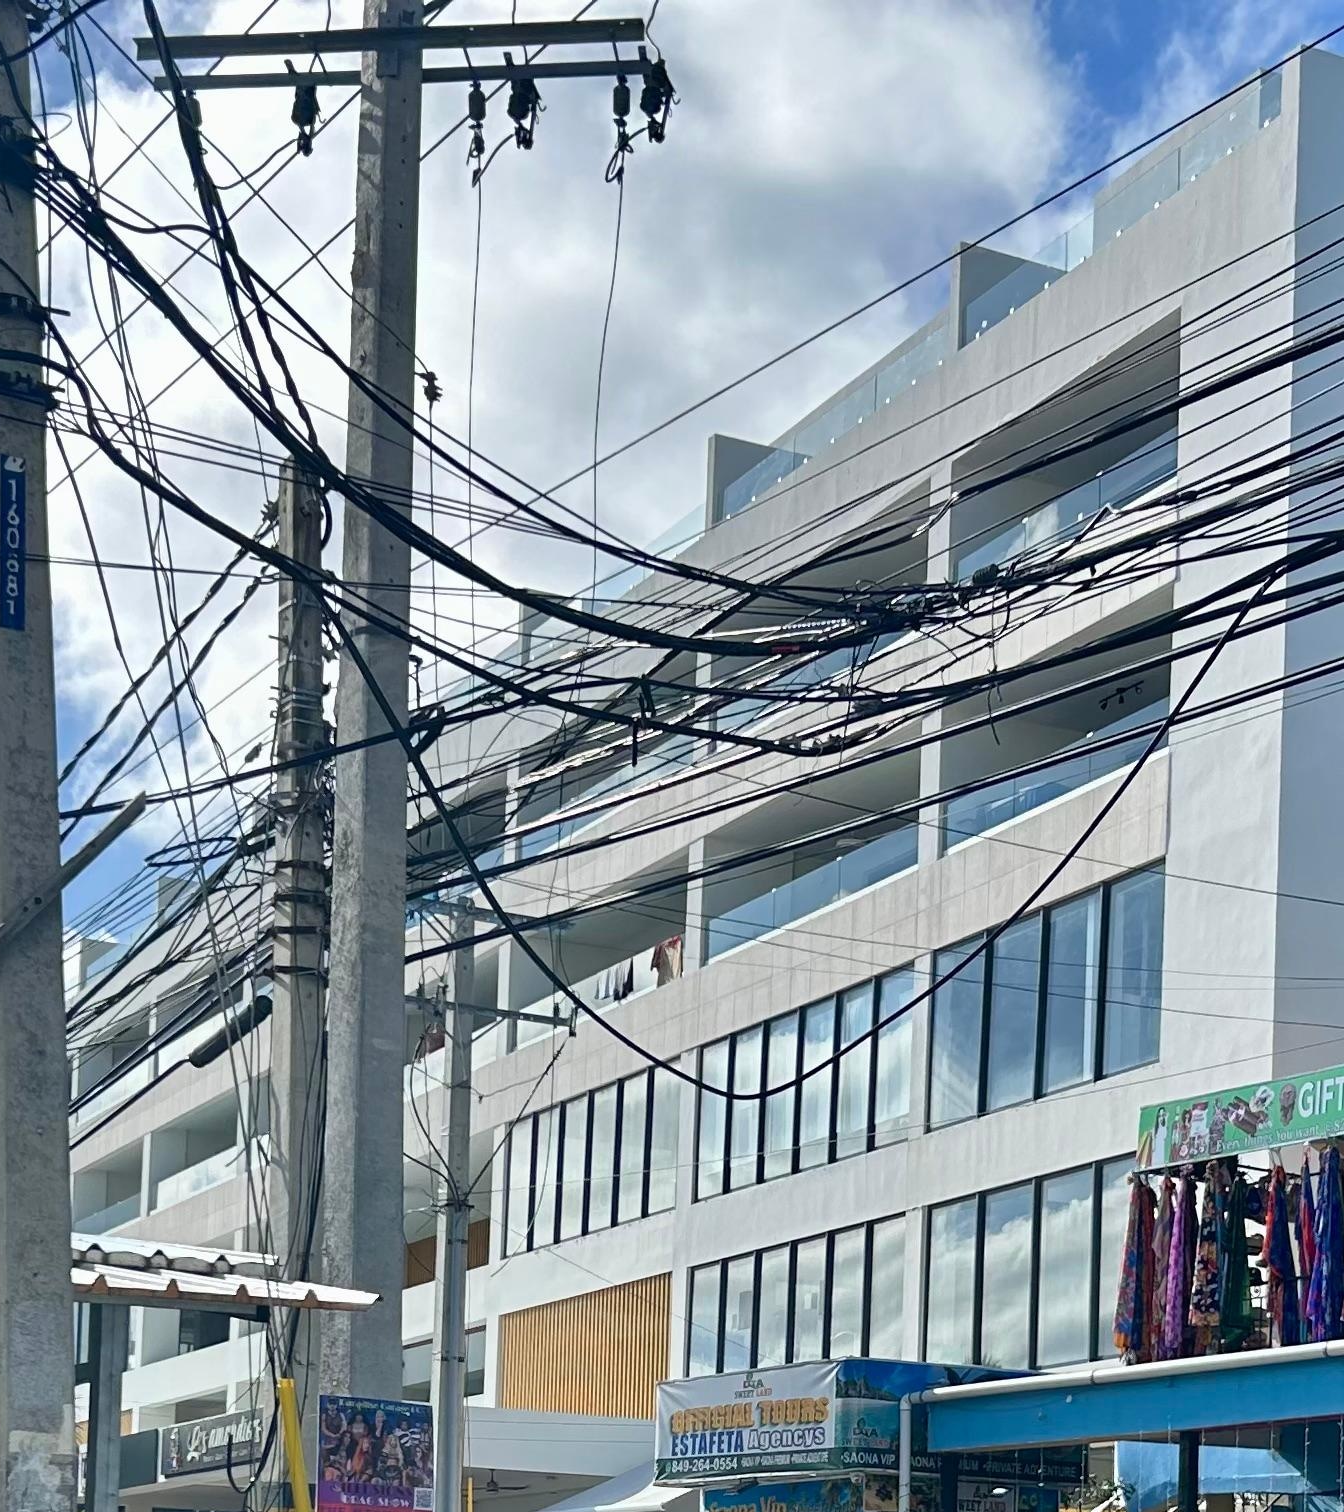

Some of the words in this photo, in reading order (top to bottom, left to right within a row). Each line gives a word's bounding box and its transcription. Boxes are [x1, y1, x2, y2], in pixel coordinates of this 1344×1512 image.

[757, 1397, 830, 1427] TOURS
[671, 1430, 744, 1457] ESTAFETA
[748, 1426, 826, 1451] Agencys
[671, 1456, 739, 1474] 849-264-0554
[843, 1451, 880, 1464] SAONA
[880, 1453, 897, 1466] VIP
[910, 1455, 935, 1468] AONA
